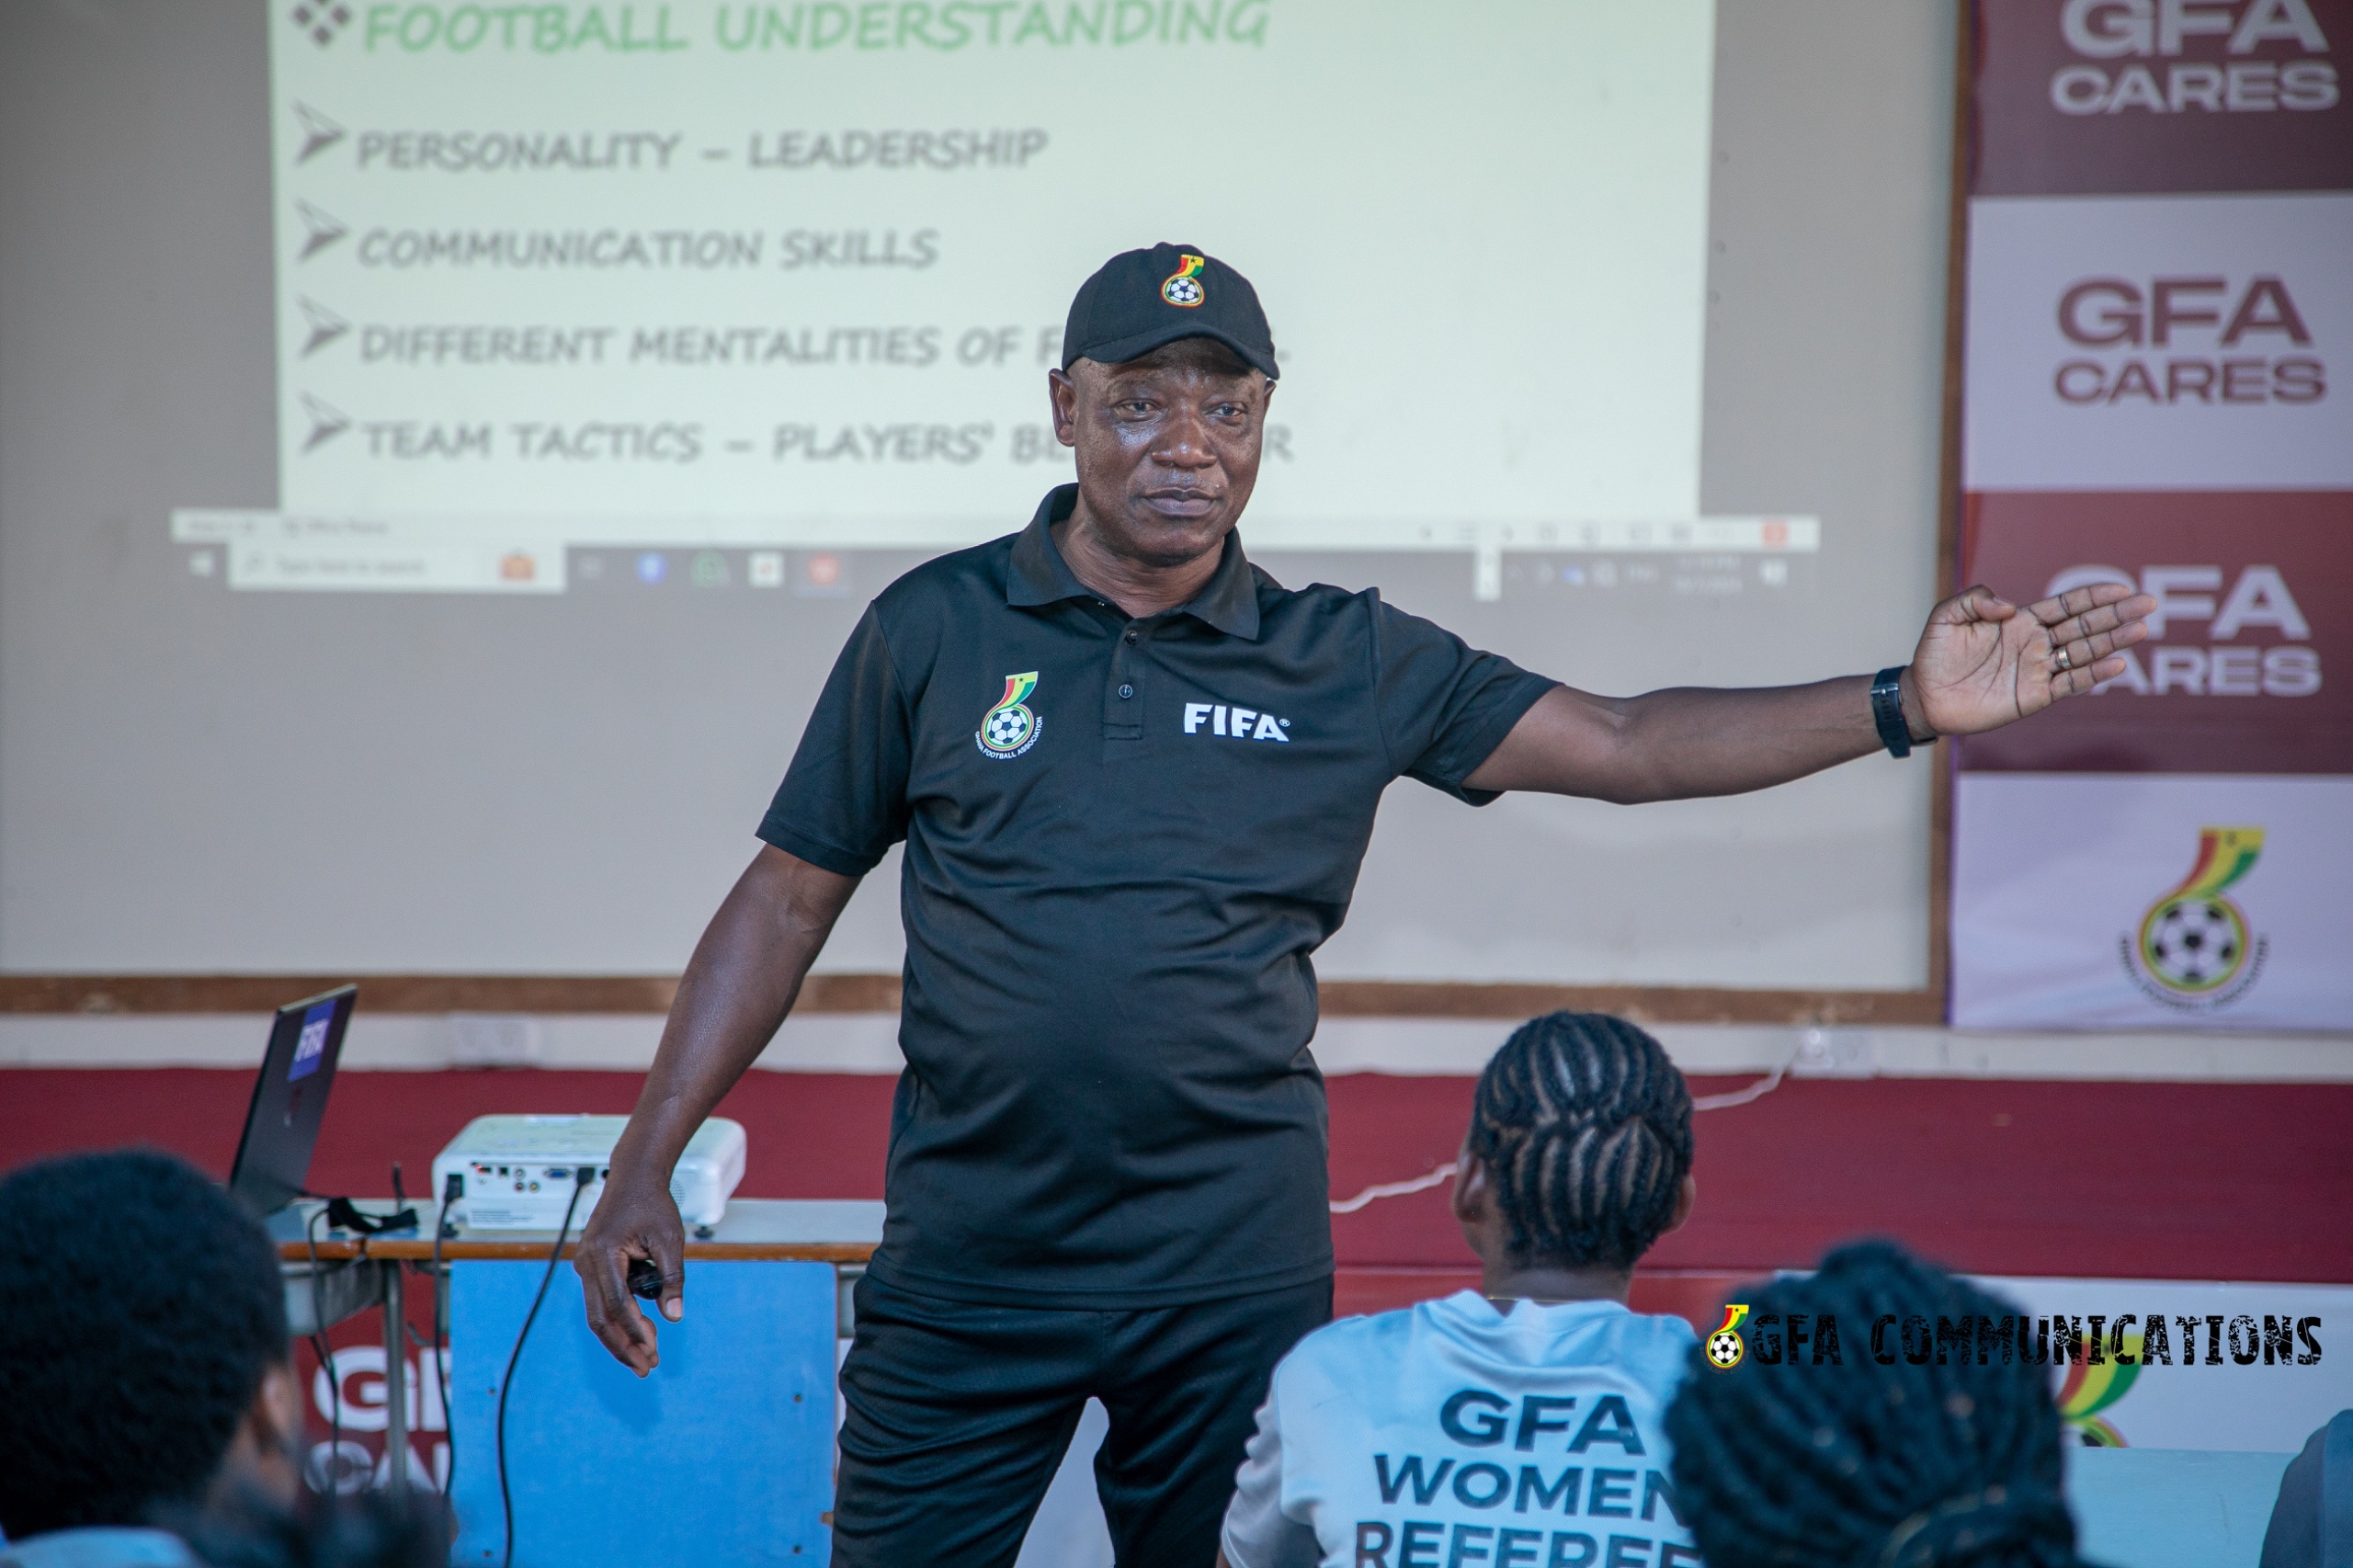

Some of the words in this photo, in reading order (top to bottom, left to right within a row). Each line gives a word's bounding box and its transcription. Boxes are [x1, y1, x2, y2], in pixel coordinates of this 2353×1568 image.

[363, 0, 691, 52] FOOTBALL
[713, 0, 1273, 52] UNDERSTANDING
[2060, 0, 2330, 59] GFA
[2049, 61, 2342, 116] CARES
[356, 131, 682, 171] PERSONALITY
[747, 128, 1050, 169] LEADERSHIP
[357, 230, 765, 268] COMMUNICATION
[779, 228, 941, 269] SKILLS
[2057, 275, 2313, 349] GFA
[359, 326, 618, 366] DIFFERENT
[629, 325, 941, 366] MENTALITIES
[956, 324, 1024, 364] OF
[2054, 358, 2327, 406] CARES
[365, 420, 494, 460] TEAM
[508, 420, 705, 461] TACTICS
[2086, 646, 2323, 696] ARES
[983, 747, 1017, 760] FOOTBALL
[1017, 716, 1043, 756] ASSOCIATION
[1439, 1389, 1647, 1457] GFA
